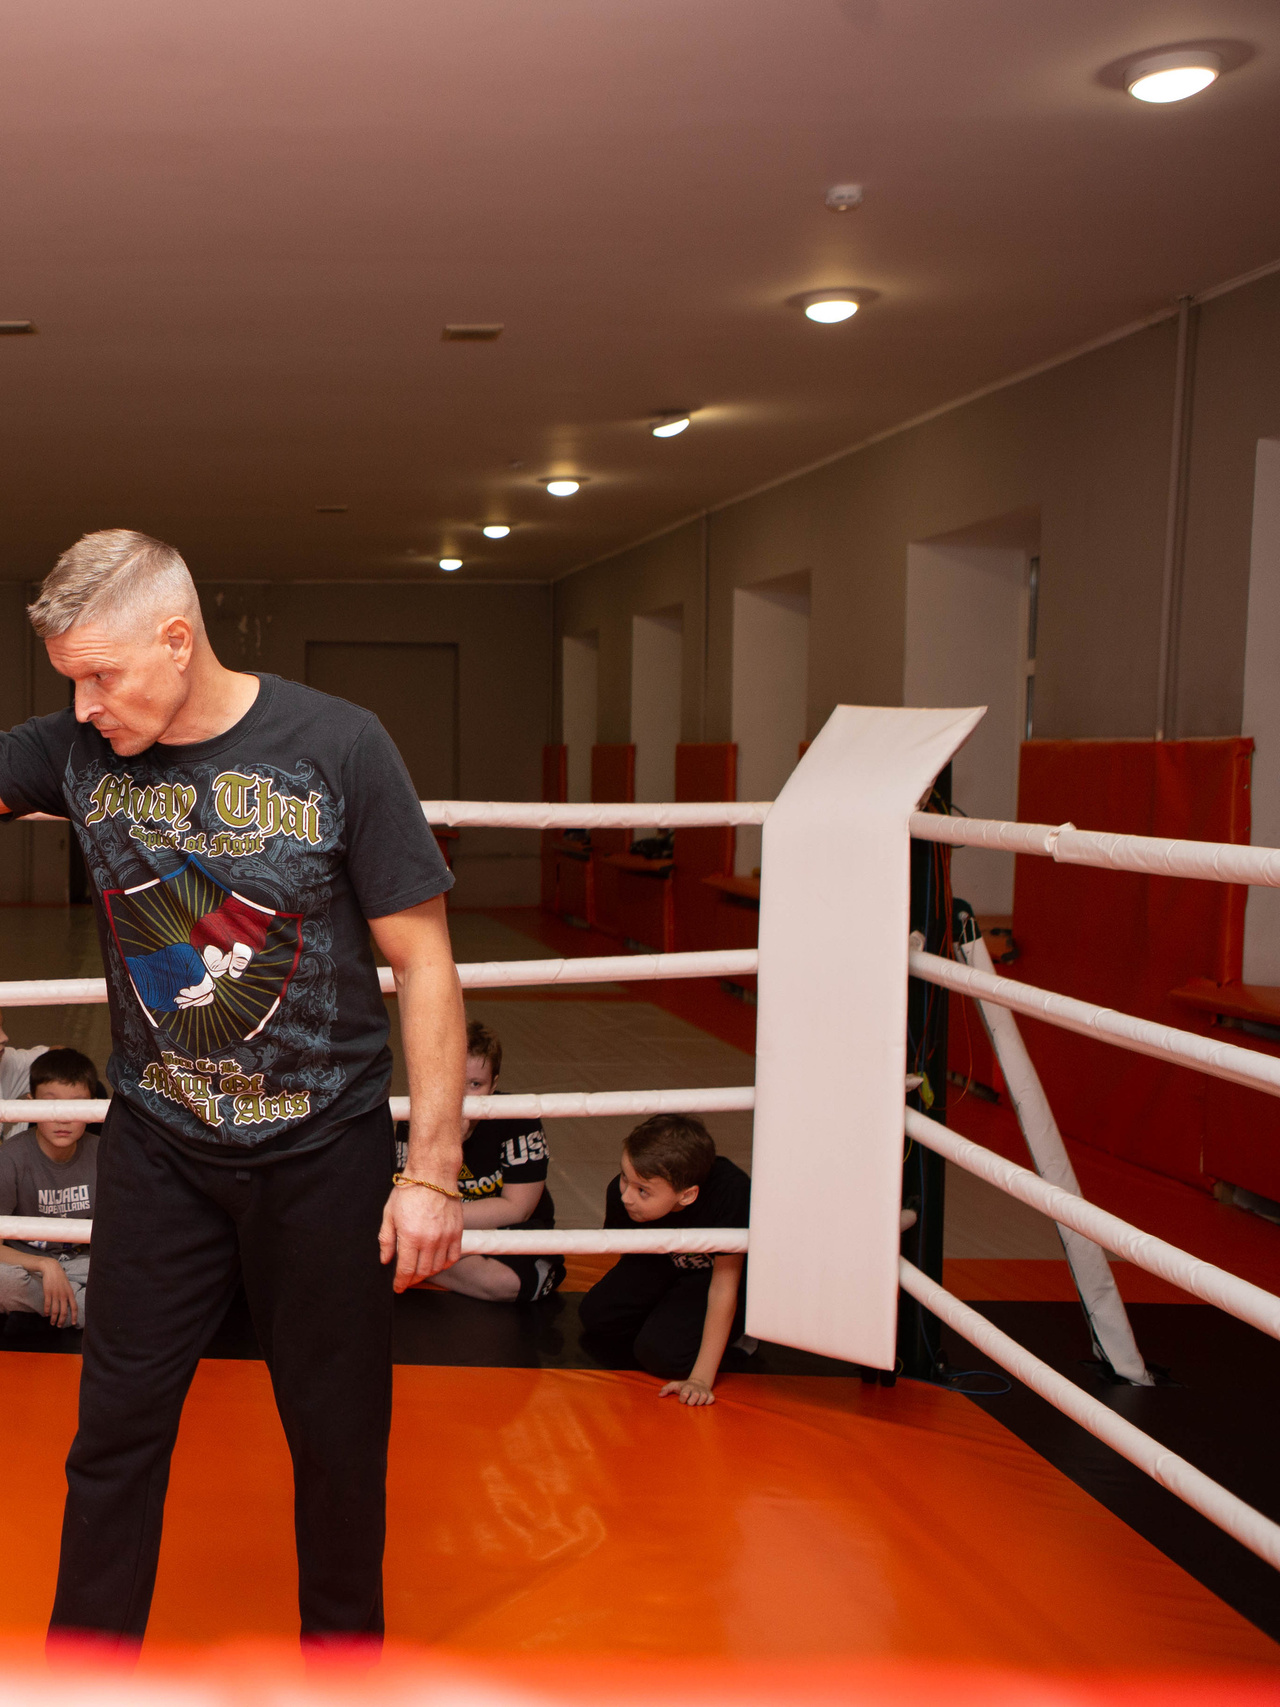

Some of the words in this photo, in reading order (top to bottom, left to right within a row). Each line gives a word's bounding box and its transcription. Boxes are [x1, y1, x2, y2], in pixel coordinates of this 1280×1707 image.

[85, 773, 197, 831] Muay
[212, 771, 322, 846] Thai
[181, 833, 207, 853] of
[208, 831, 265, 857] Fight
[195, 1058, 217, 1073] To
[220, 1074, 265, 1096] Of
[233, 1091, 310, 1125] Arts
